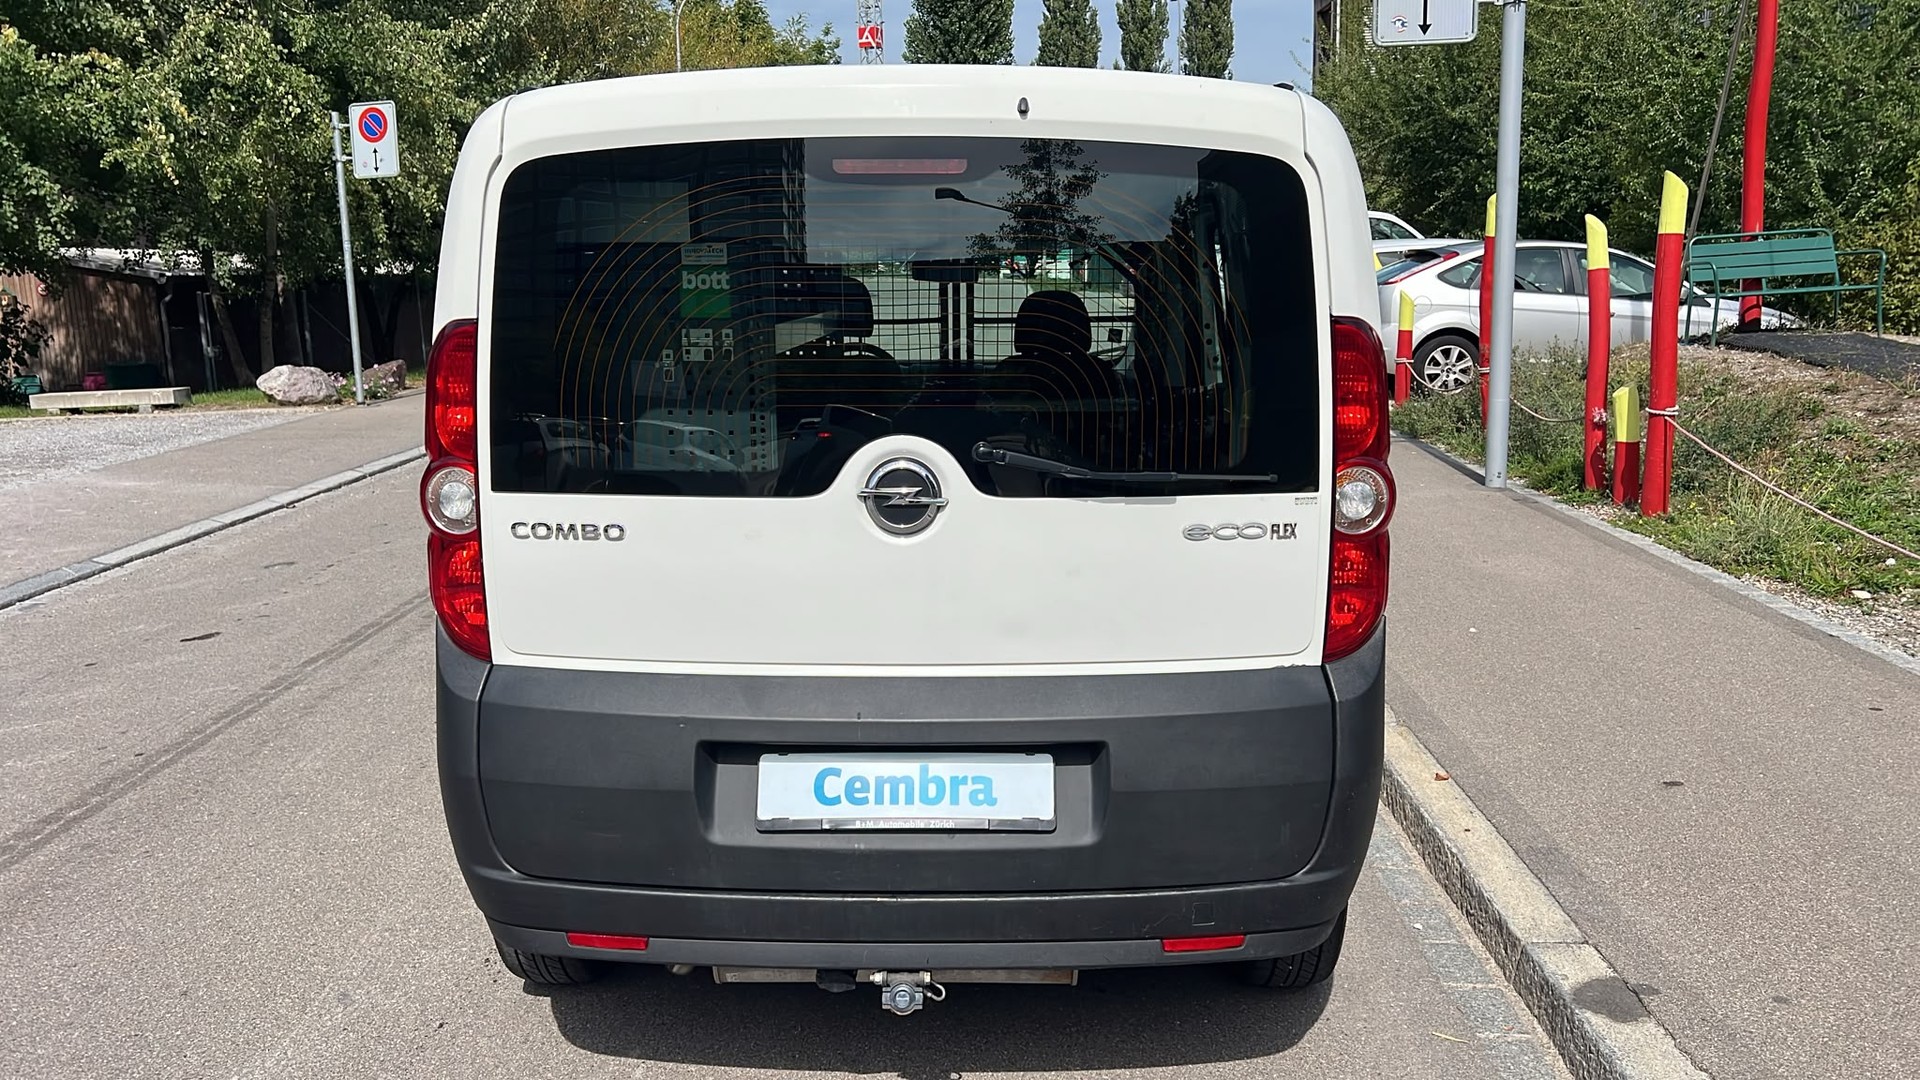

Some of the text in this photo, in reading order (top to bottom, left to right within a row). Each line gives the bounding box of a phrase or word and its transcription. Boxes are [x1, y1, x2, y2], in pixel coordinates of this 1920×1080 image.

[682, 271, 730, 290] bott
[510, 522, 625, 541] COMBO
[813, 764, 998, 807] Cembra
[879, 820, 925, 828] Automobile
[929, 820, 955, 828] Zürich
